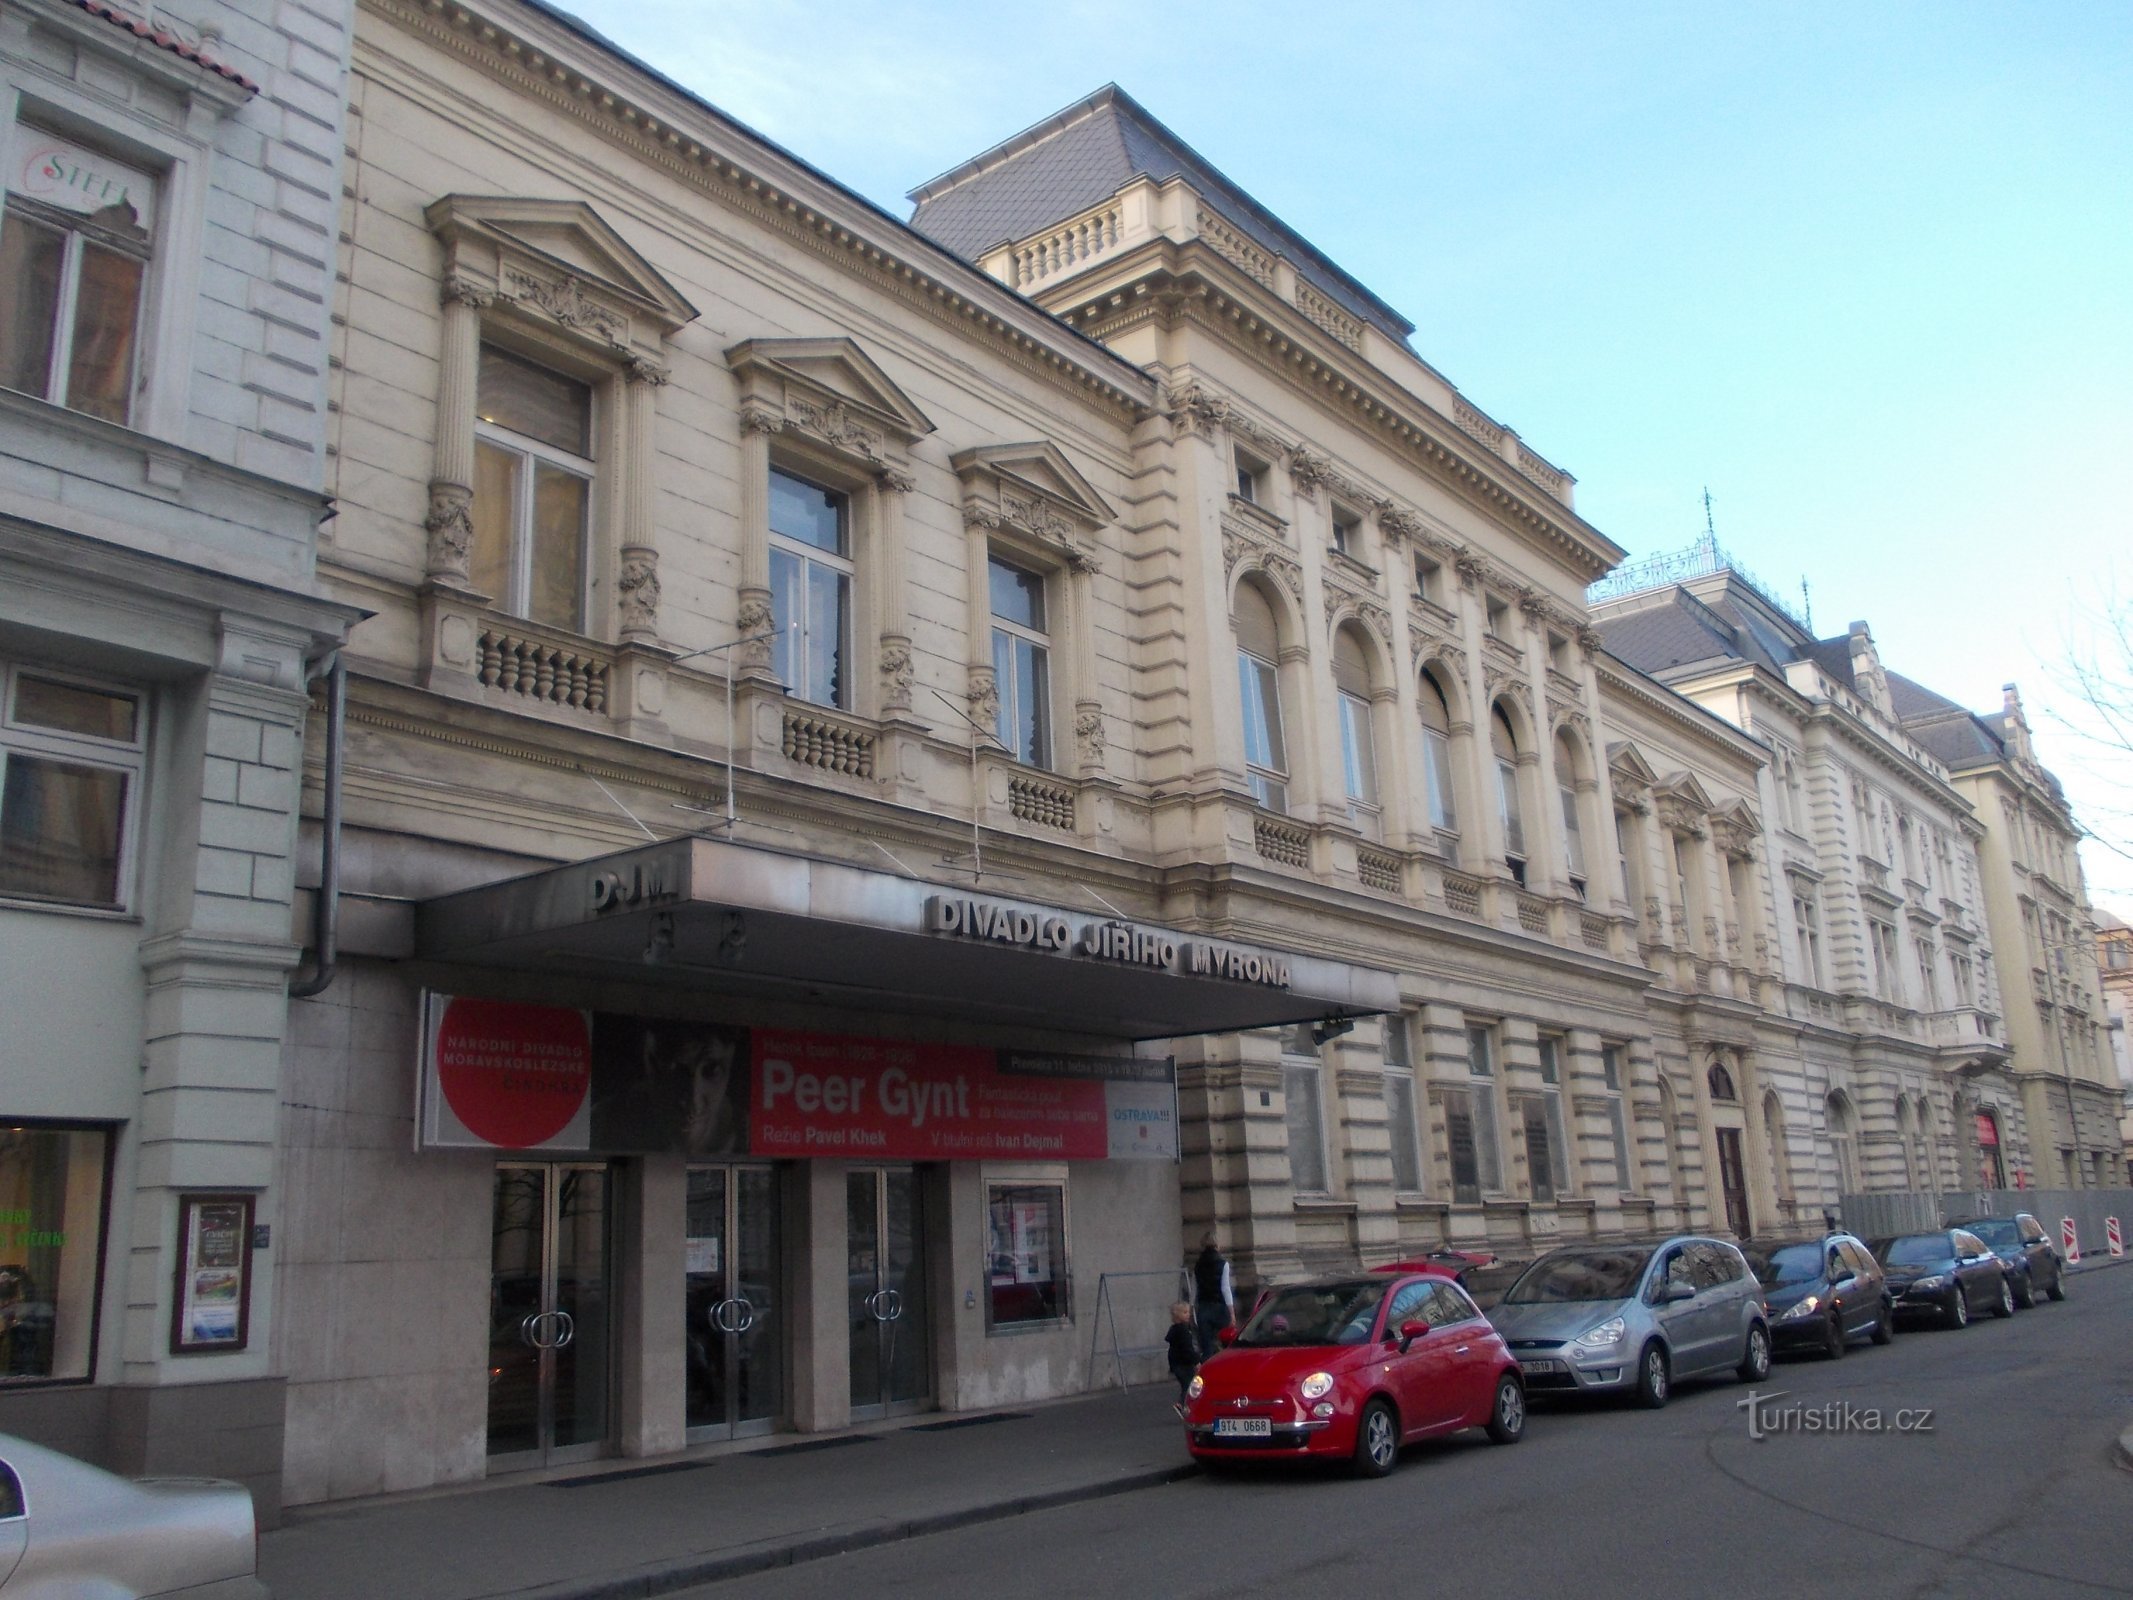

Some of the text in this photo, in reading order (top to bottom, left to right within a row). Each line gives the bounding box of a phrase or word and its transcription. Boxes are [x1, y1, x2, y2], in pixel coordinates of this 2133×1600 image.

[589, 860, 679, 912] DJM
[926, 894, 1073, 951] DIVADLO
[1181, 942, 1293, 990] MYRONA
[522, 1041, 583, 1058] DIVADLO
[762, 1058, 970, 1128] Peer Gynt
[1114, 1107, 1170, 1122] OSTRAVA!!!
[763, 1124, 801, 1144] Režie
[805, 1126, 846, 1145] Pavel
[850, 1128, 887, 1146] Khek
[995, 1132, 1020, 1149] Ivan
[1023, 1133, 1064, 1151] Dejmal
[1221, 1420, 1267, 1432] 9T4 0668
